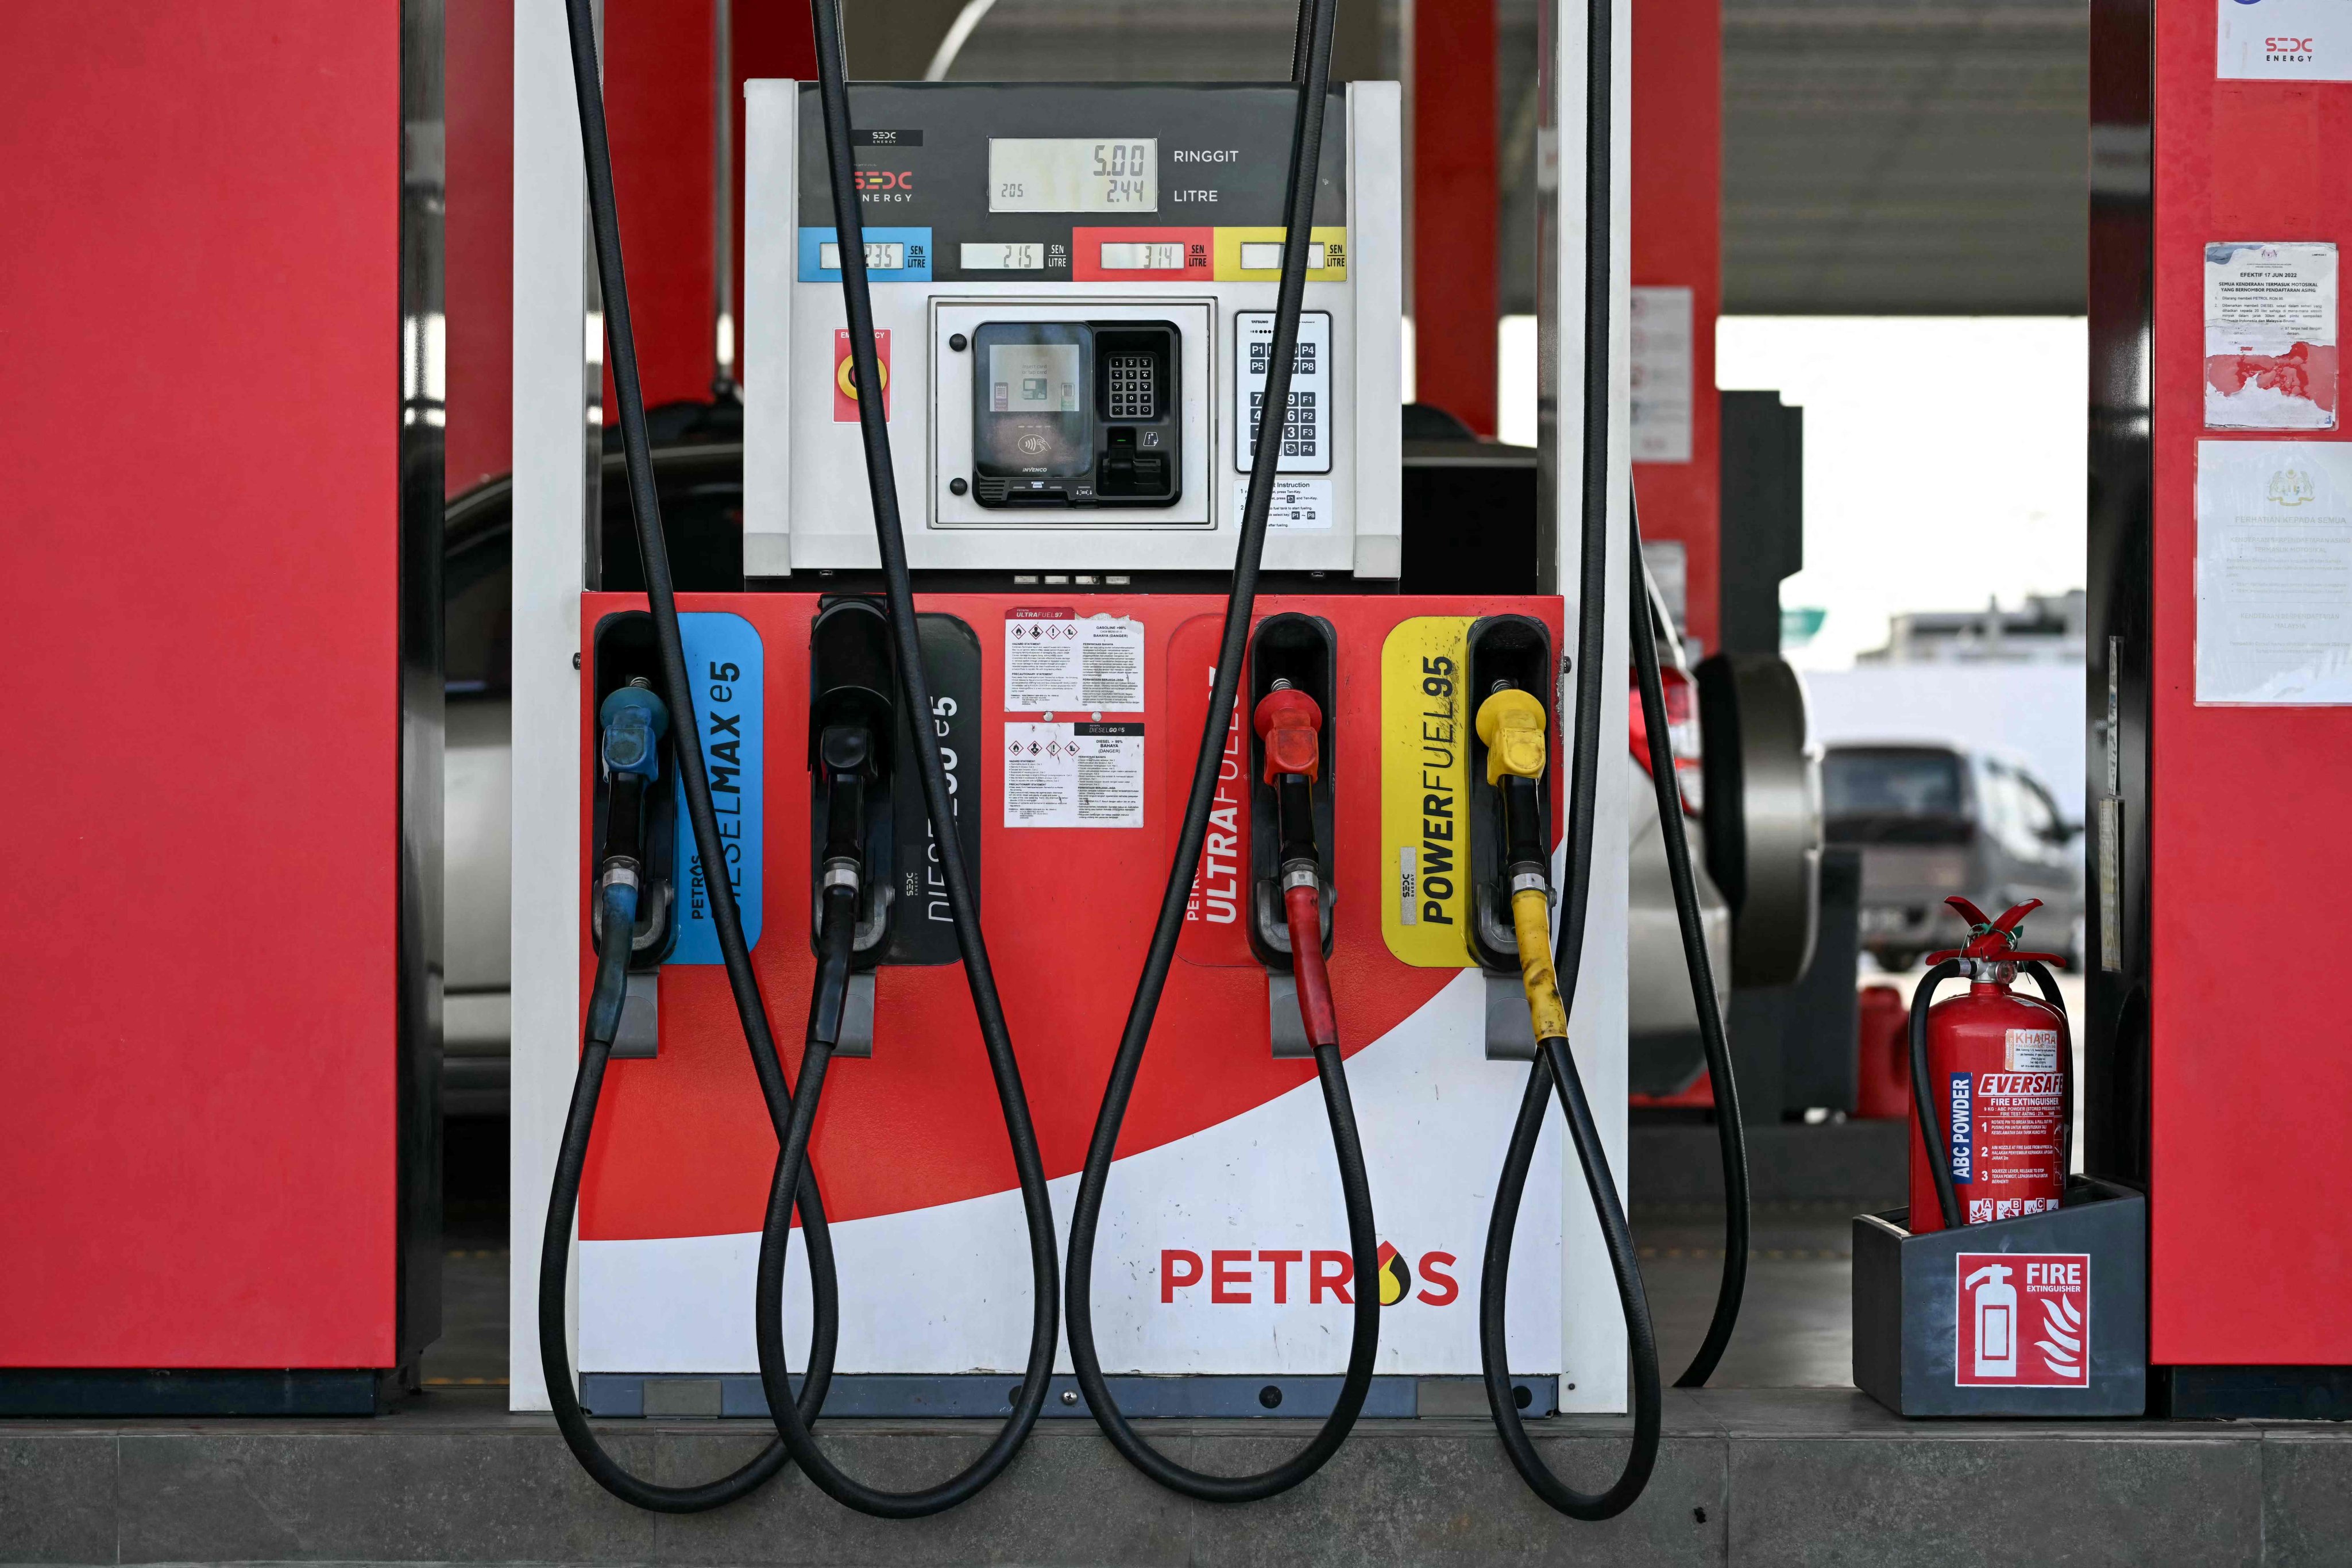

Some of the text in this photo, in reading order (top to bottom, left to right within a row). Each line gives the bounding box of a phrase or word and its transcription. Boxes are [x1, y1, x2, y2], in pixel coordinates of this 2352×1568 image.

[2265, 37, 2312, 52] SEDC
[1093, 145, 1145, 176] 5.00
[1174, 150, 1239, 162] RINGGIT
[1106, 180, 1144, 203] 2.44
[1174, 191, 1218, 202] LITRE
[863, 194, 912, 202] NERGY
[910, 245, 924, 255] SEN
[1051, 245, 1064, 254] SEN
[1191, 245, 1205, 254] SEN
[1330, 245, 1343, 254] SEN
[1003, 245, 1032, 268] 215
[907, 258, 926, 268] LITRE
[1048, 258, 1067, 268] LITRE
[1188, 257, 1207, 267] LITRE
[1327, 257, 1345, 267] LITRE
[1252, 346, 1314, 354] P1 P4
[1252, 362, 1314, 370] P5 P8
[1254, 394, 1262, 404] 7
[1288, 394, 1295, 404] 9
[1287, 410, 1295, 421] 6
[1287, 427, 1295, 437] 3
[710, 662, 740, 702] e5
[2015, 1032, 2056, 1044] KHAIRA
[1980, 1075, 2063, 1094] EVERSAFE
[1991, 1098, 2059, 1106] FIRE EXTINGUISHER
[1953, 1079, 1969, 1178] ABC POWDER
[1982, 1122, 1987, 1132] 1
[1982, 1146, 1988, 1157] 2
[1982, 1171, 1988, 1181] 3
[1984, 1200, 1991, 1208] A
[2037, 1200, 2043, 1208] C
[1161, 1239, 1459, 1307] PETROS
[2026, 1264, 2081, 1284] FIRE
